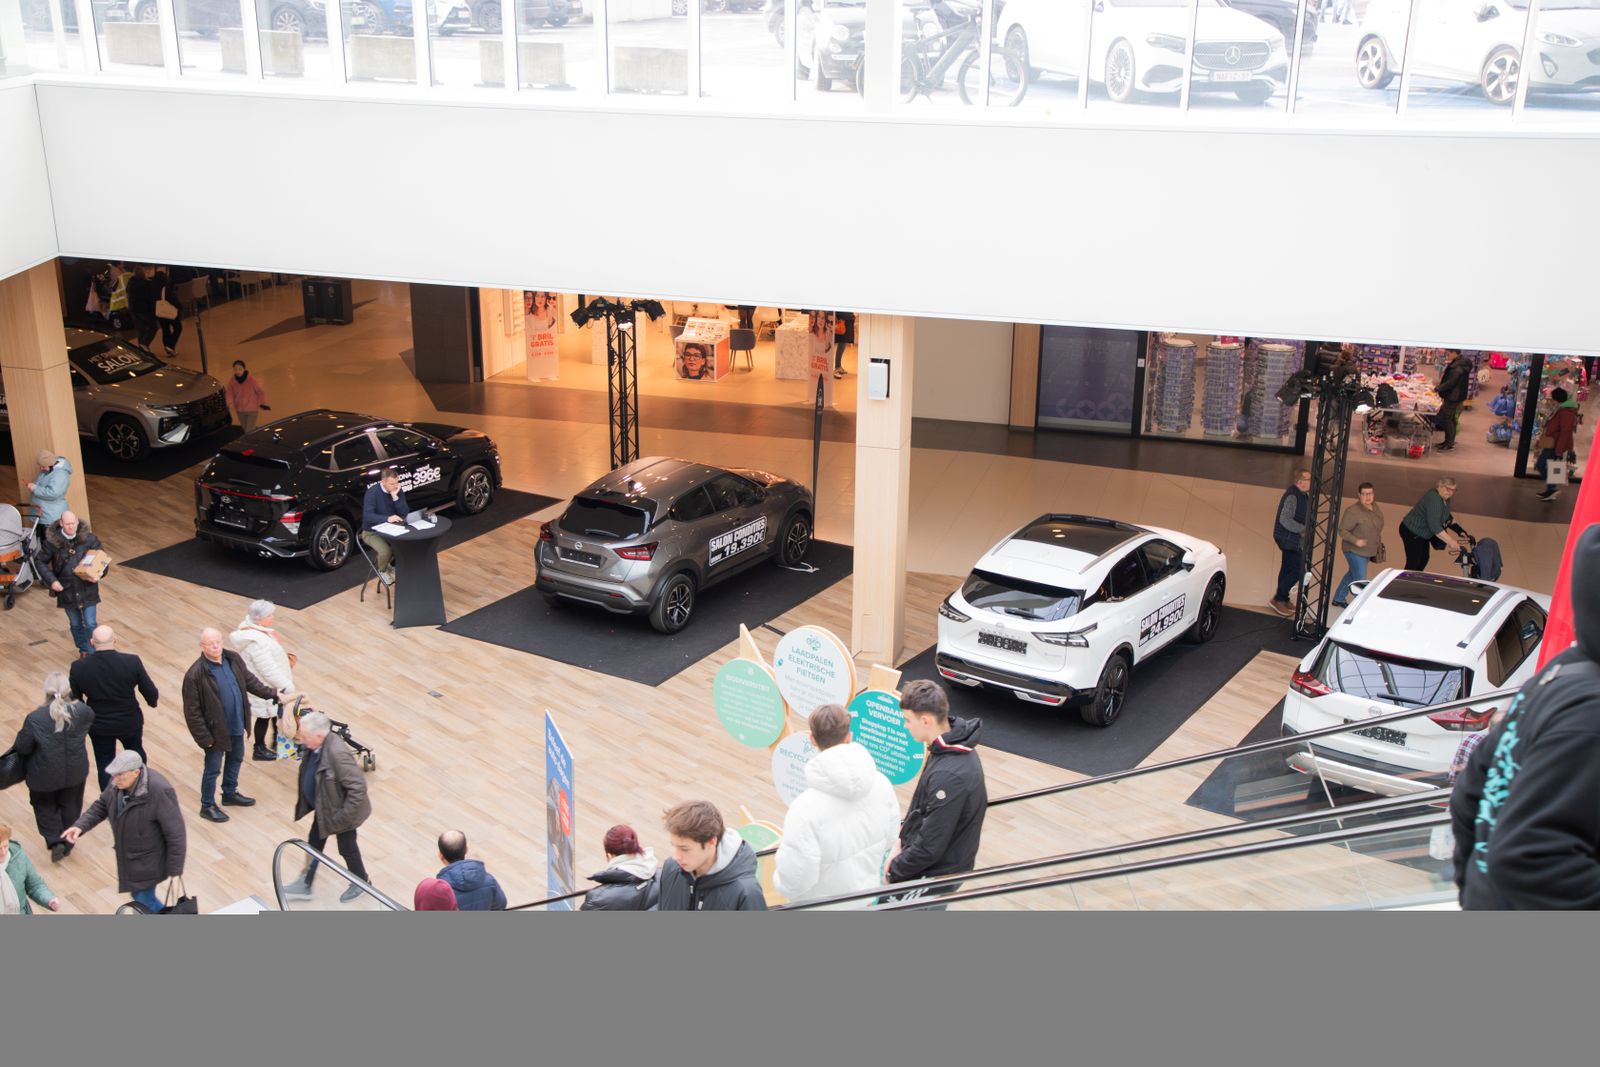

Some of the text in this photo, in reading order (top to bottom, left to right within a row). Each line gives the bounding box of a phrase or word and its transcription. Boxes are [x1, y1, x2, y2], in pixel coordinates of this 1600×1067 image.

[530, 340, 554, 348] GRATIS
[537, 332, 553, 341] BRIL
[97, 353, 142, 373] SALON
[412, 466, 441, 485] 396€
[711, 532, 733, 552] SALON
[724, 529, 765, 556] 19.390€
[1141, 610, 1159, 633] SALON
[788, 654, 836, 679] ELEKTRISCHE
[791, 646, 834, 669] LAADPALEN
[796, 667, 826, 685] FIETSEN
[861, 717, 886, 732] Shopping
[868, 709, 901, 727] VERVOER
